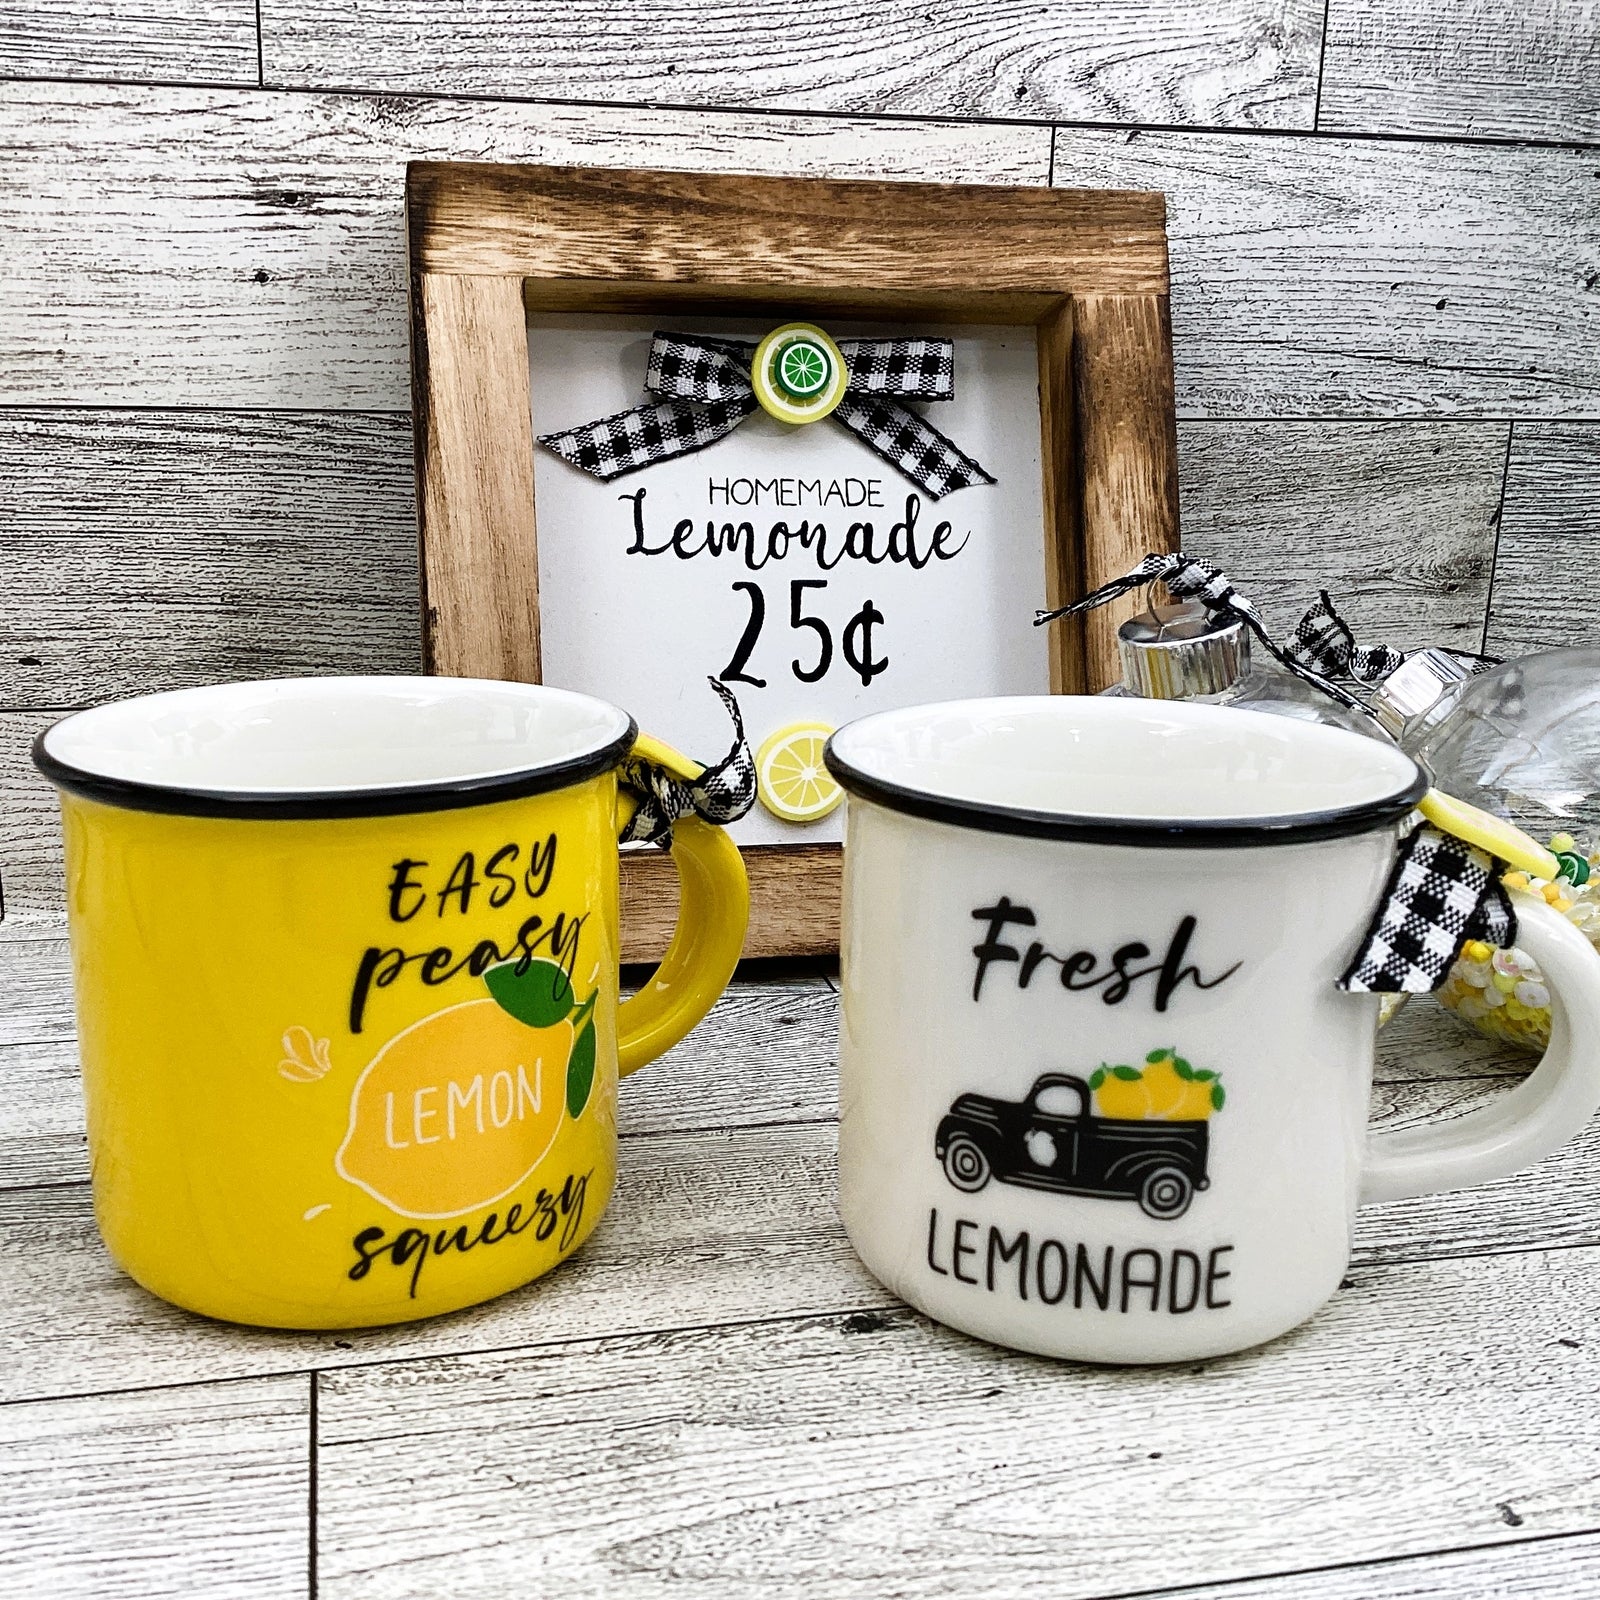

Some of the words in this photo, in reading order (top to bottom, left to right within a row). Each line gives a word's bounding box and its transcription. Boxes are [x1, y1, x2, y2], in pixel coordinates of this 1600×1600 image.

[618, 487, 971, 569] Lemonade
[709, 477, 885, 508] HOMEMADE
[719, 579, 889, 688] 25¢
[388, 832, 557, 922] EASY
[350, 911, 590, 1034] peasy
[971, 895, 1245, 1012] Fresh
[384, 1057, 544, 1150] LEMON
[348, 1167, 595, 1299] squeezy
[928, 1207, 1235, 1314] LEMONADE
